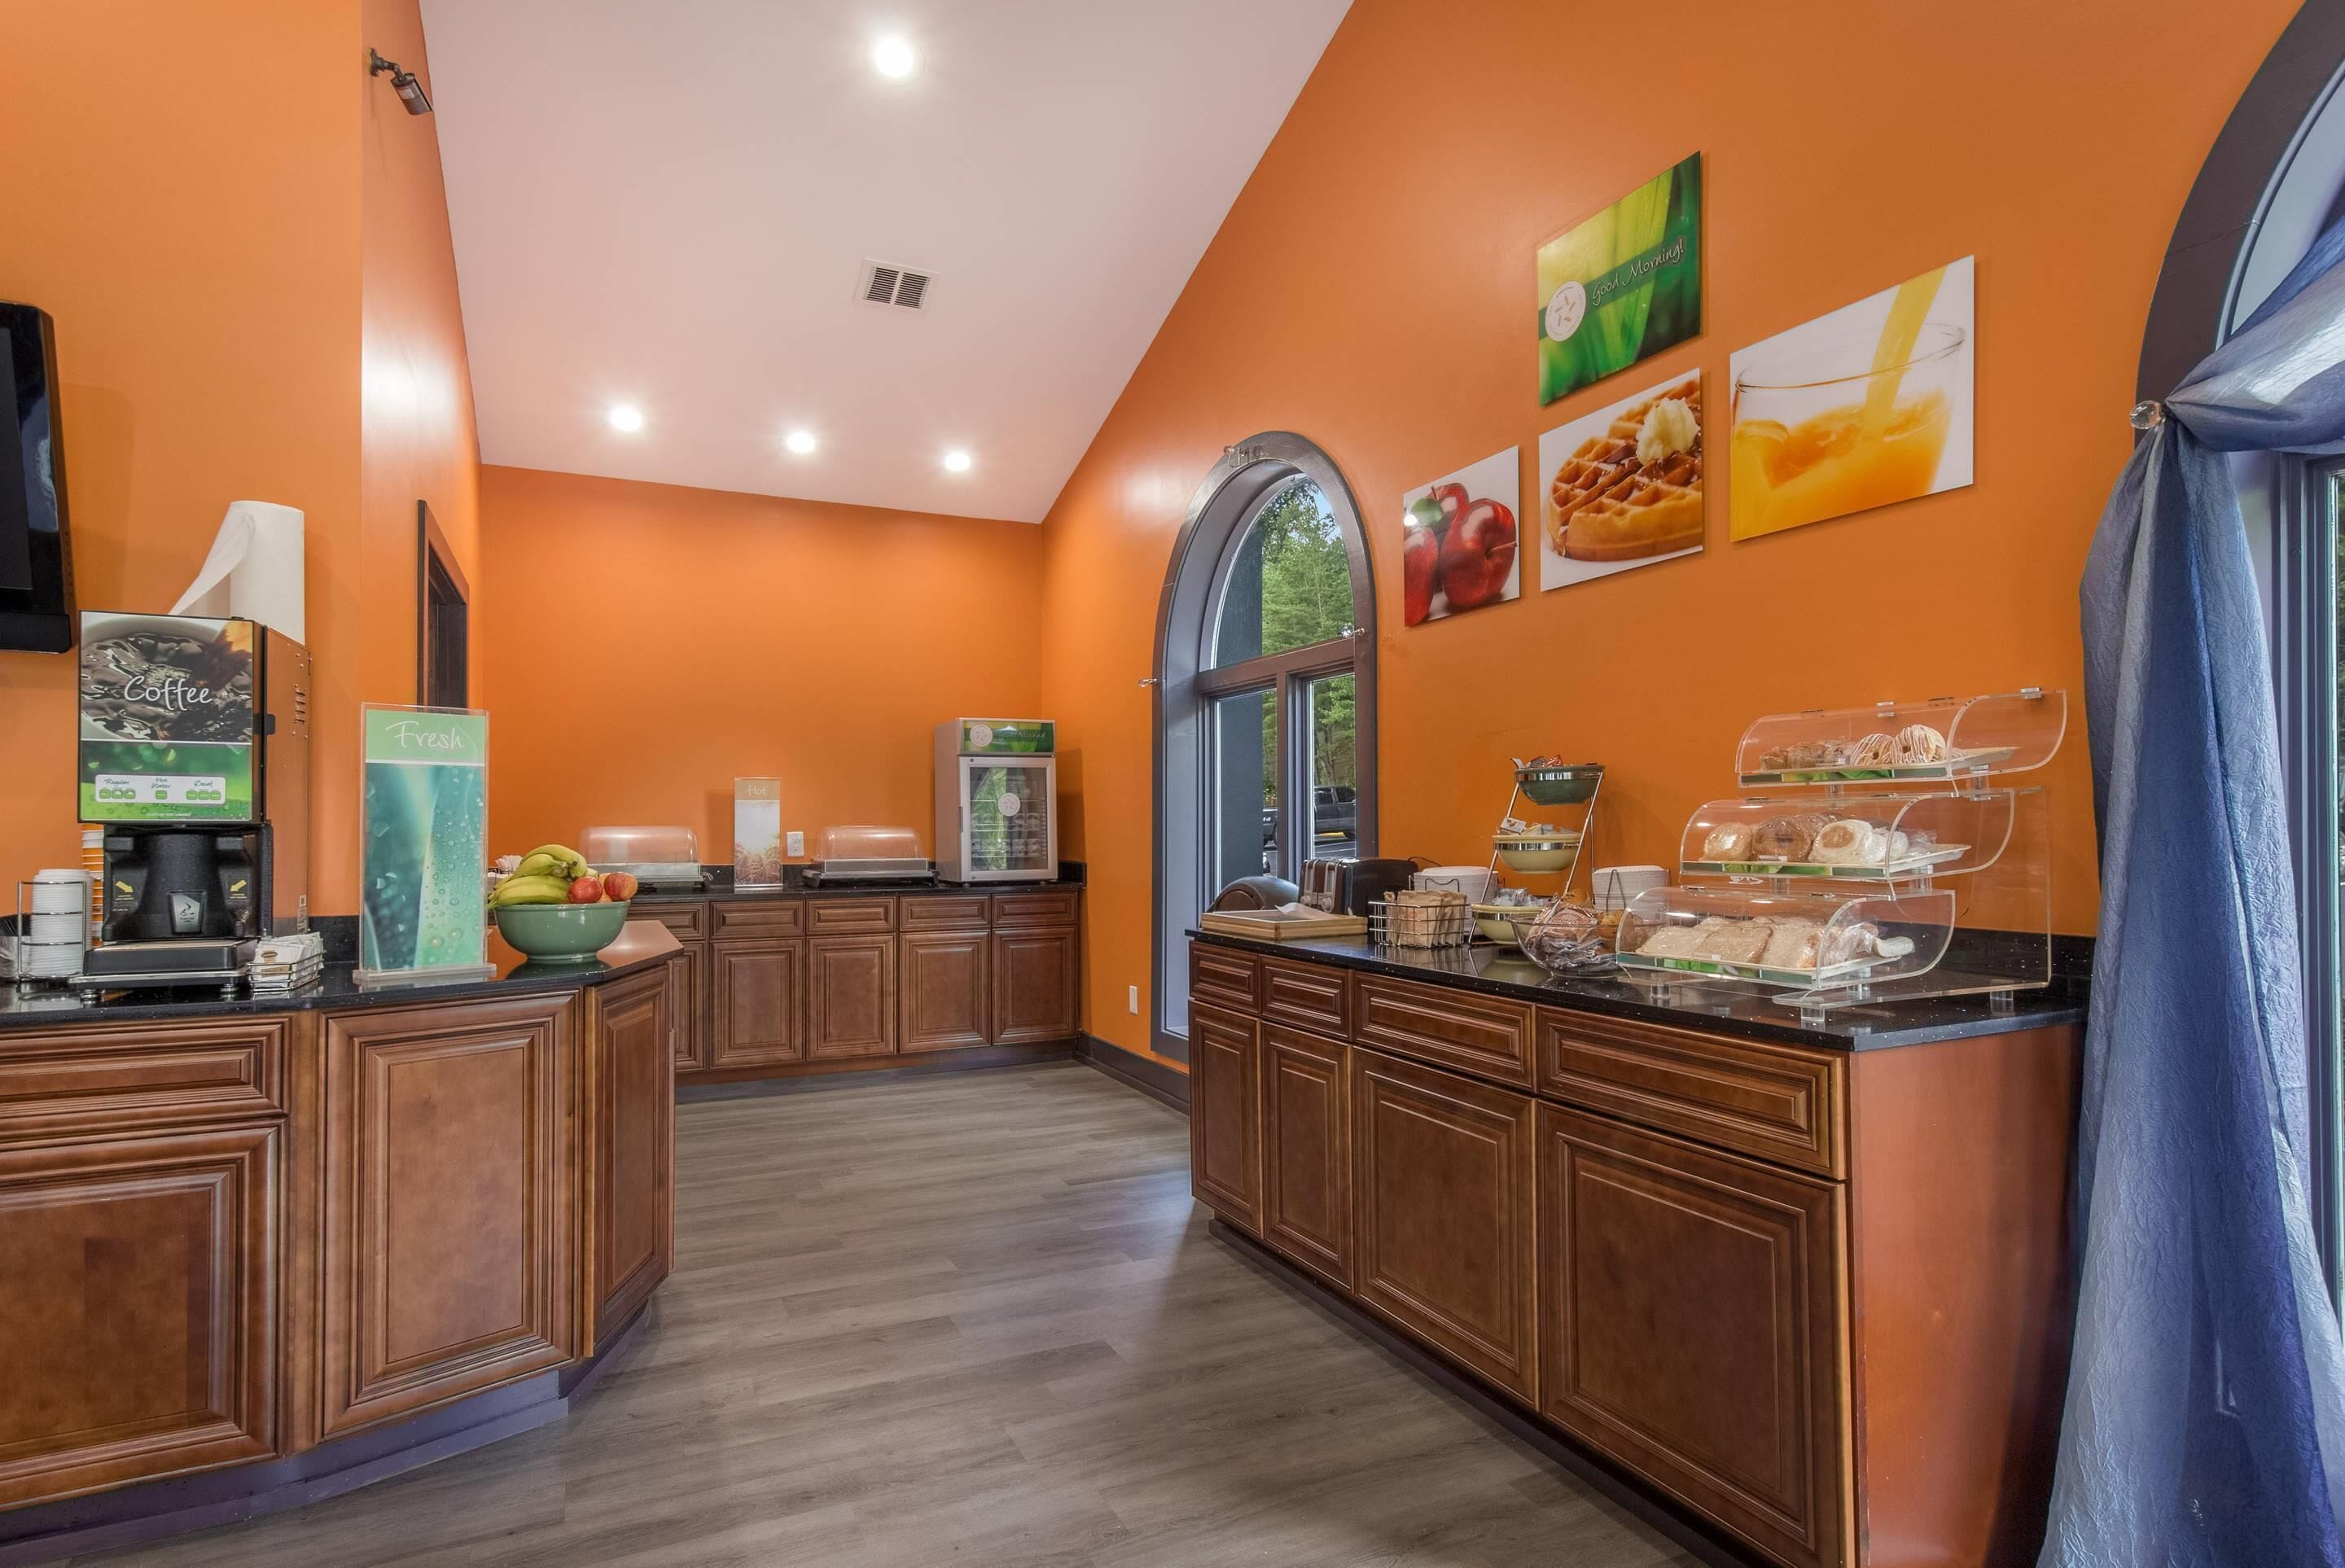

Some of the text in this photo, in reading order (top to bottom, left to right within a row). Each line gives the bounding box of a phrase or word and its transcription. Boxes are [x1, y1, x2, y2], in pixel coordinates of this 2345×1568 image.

[1591, 238, 1685, 306] Good Morning!
[124, 675, 213, 711] Coffee
[385, 720, 465, 750] Fresh
[103, 778, 130, 787] Regular
[745, 785, 767, 796] Hot
